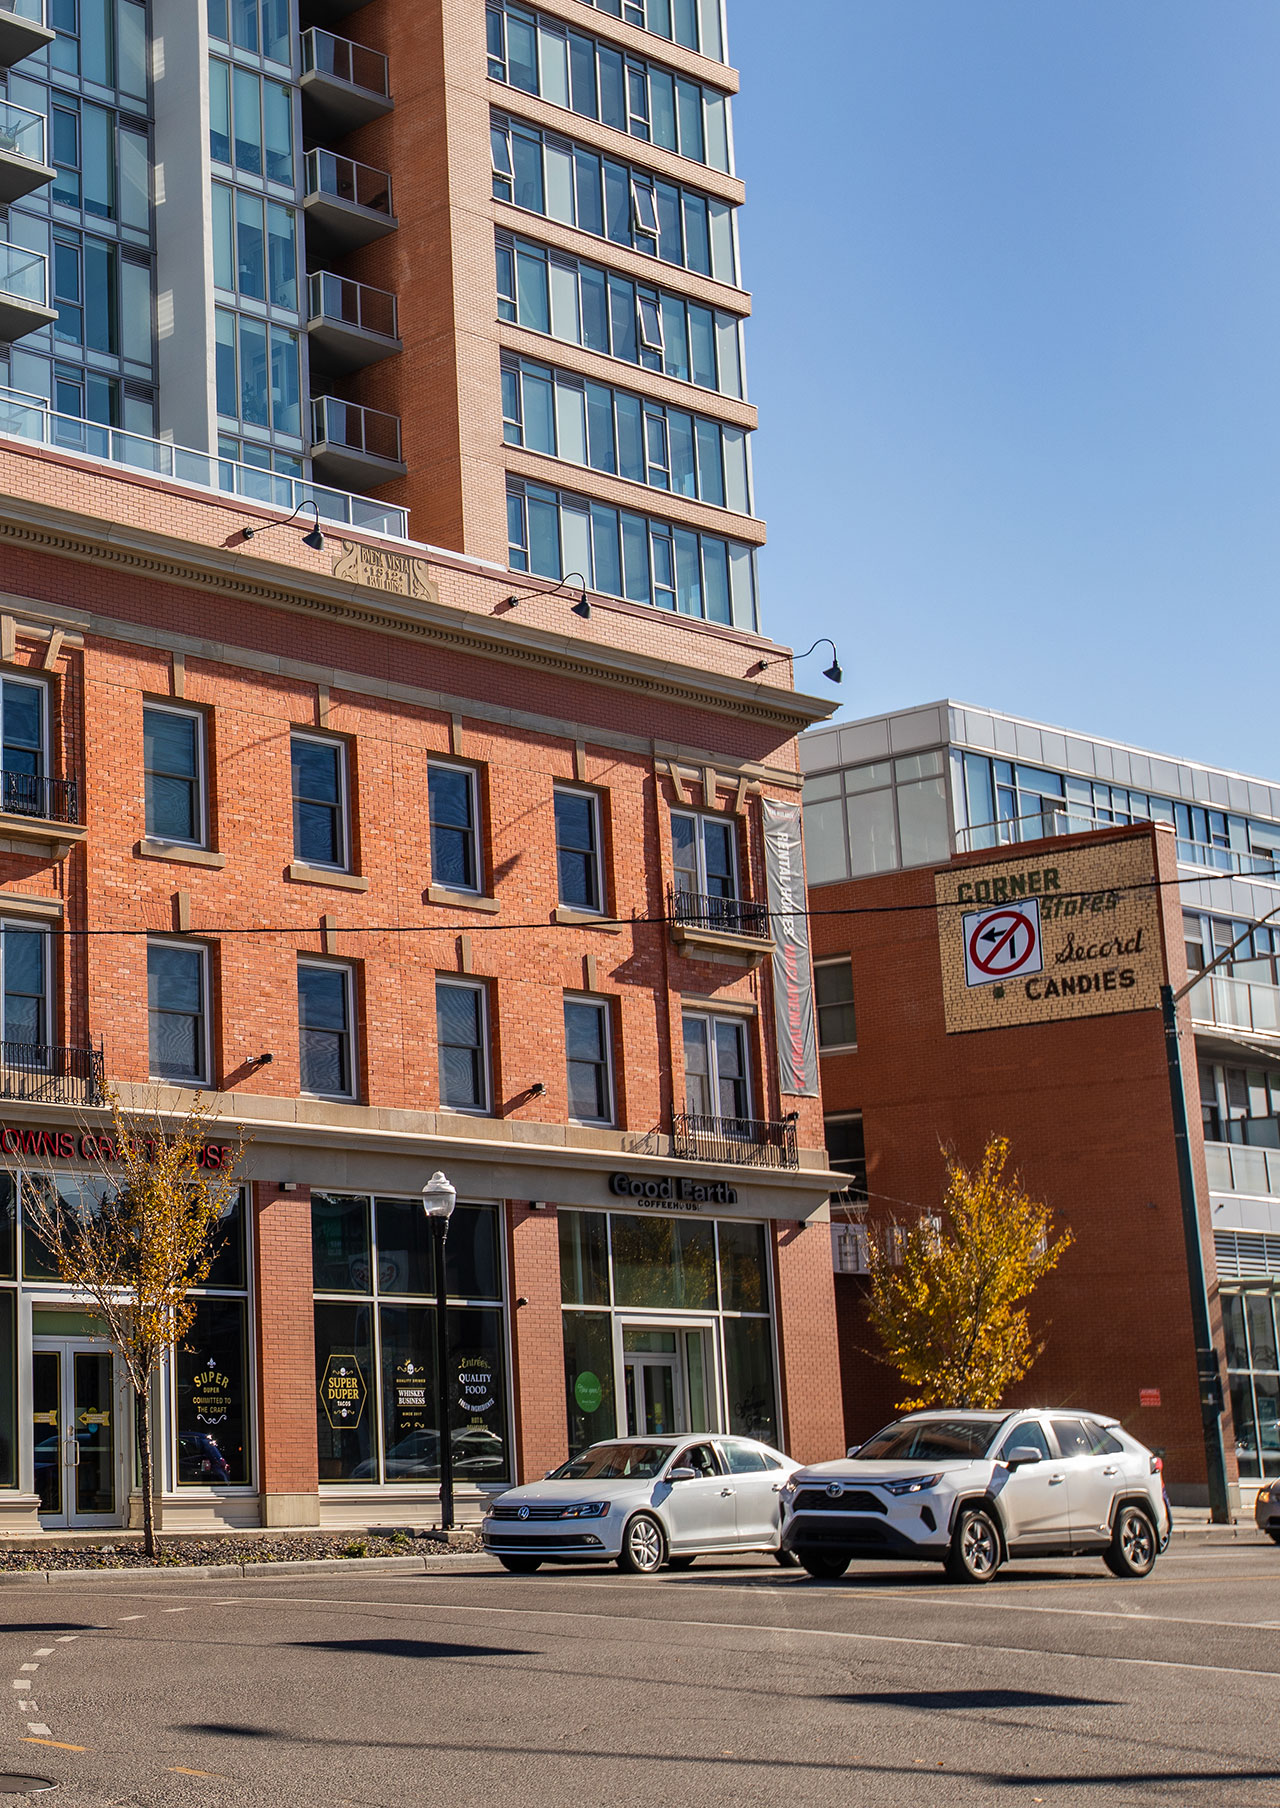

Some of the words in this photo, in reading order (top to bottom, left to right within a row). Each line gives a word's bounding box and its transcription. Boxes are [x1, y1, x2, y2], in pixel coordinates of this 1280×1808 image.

[777, 832, 792, 881] RENTAL
[957, 868, 1061, 903] CORNER
[1040, 893, 1119, 920] Stores
[1055, 928, 1145, 965] Secord
[1025, 969, 1136, 1000] CANDIES
[610, 1173, 672, 1200] Good
[680, 1177, 738, 1204] Earth
[193, 1371, 229, 1389] SUPER
[328, 1377, 358, 1389] SUPER
[458, 1373, 491, 1384] QUALITY
[328, 1388, 360, 1400] DUPER
[398, 1389, 425, 1397] WHISKEY
[465, 1385, 487, 1394] FOOD
[192, 1396, 223, 1404] COMMITTED
[398, 1397, 426, 1405] BUSINESS
